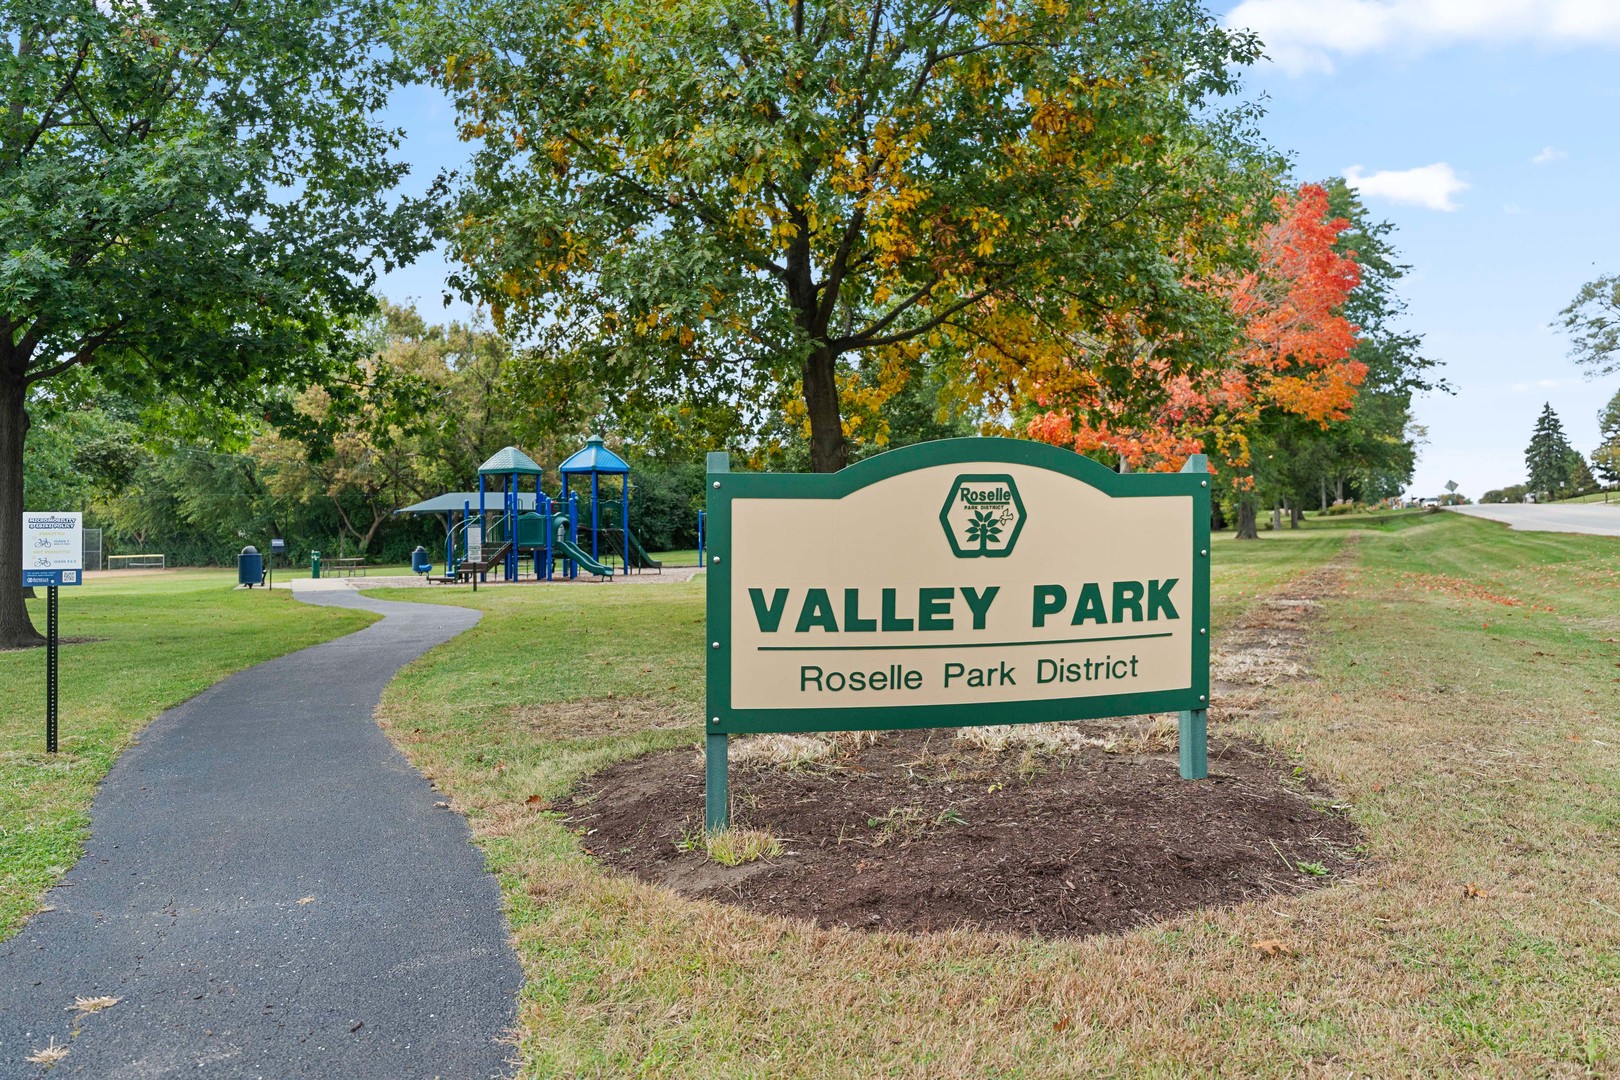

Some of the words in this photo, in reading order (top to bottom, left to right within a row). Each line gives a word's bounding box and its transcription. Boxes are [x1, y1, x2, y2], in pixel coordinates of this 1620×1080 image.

[960, 487, 1011, 503] Roselle
[748, 586, 1001, 633] VALLEY
[1033, 579, 1181, 628] PARK
[801, 664, 923, 692] Roselle
[944, 658, 1017, 689] Park
[1037, 654, 1138, 684] District
